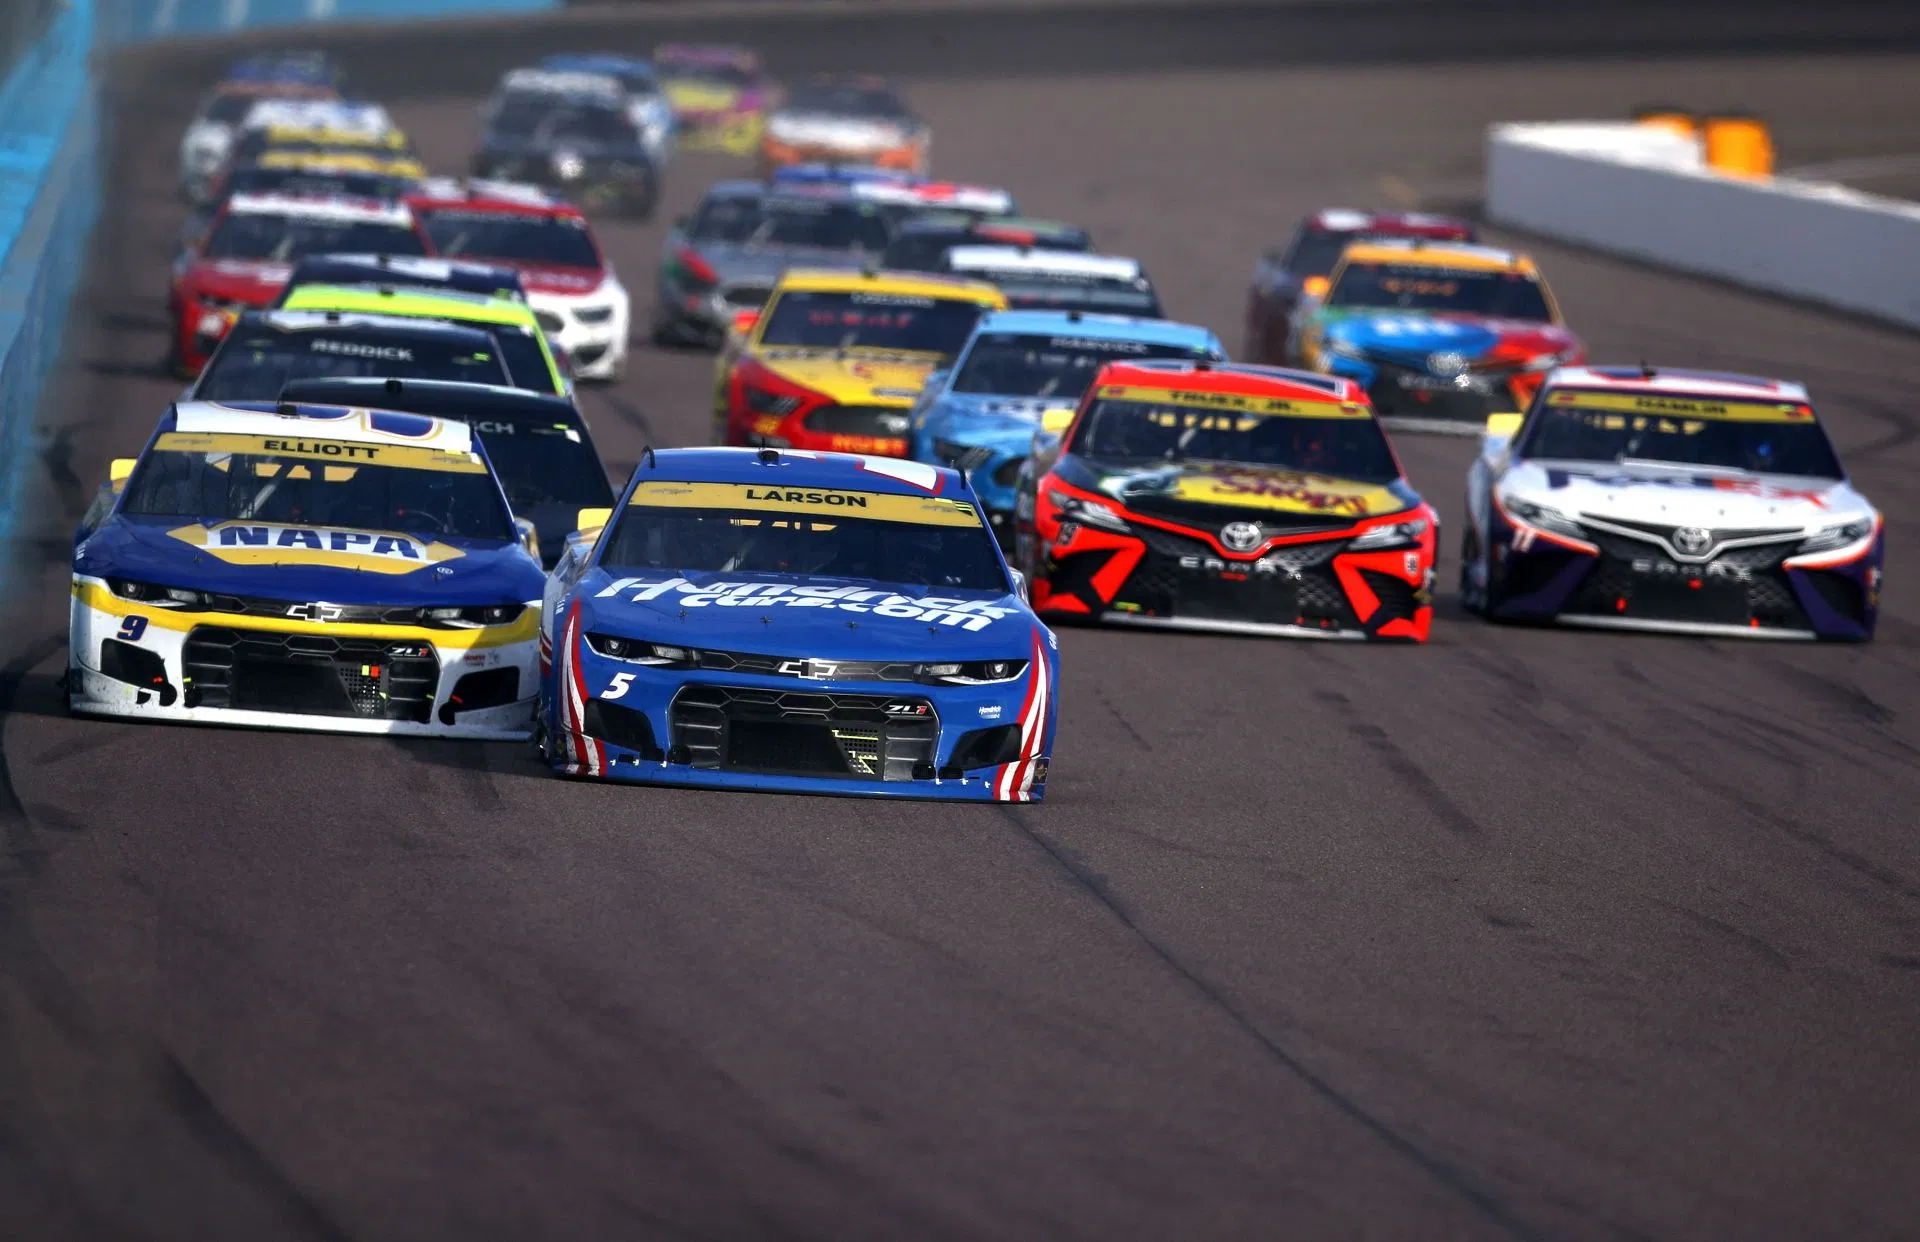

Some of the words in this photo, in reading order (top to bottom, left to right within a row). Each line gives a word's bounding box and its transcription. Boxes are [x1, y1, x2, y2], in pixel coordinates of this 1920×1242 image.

[311, 338, 414, 361] REDDICK
[263, 440, 380, 459] ELLIOTT
[746, 488, 868, 508] LARSON
[220, 526, 420, 560] NAPA
[117, 614, 150, 642] 9
[600, 672, 637, 700] 5
